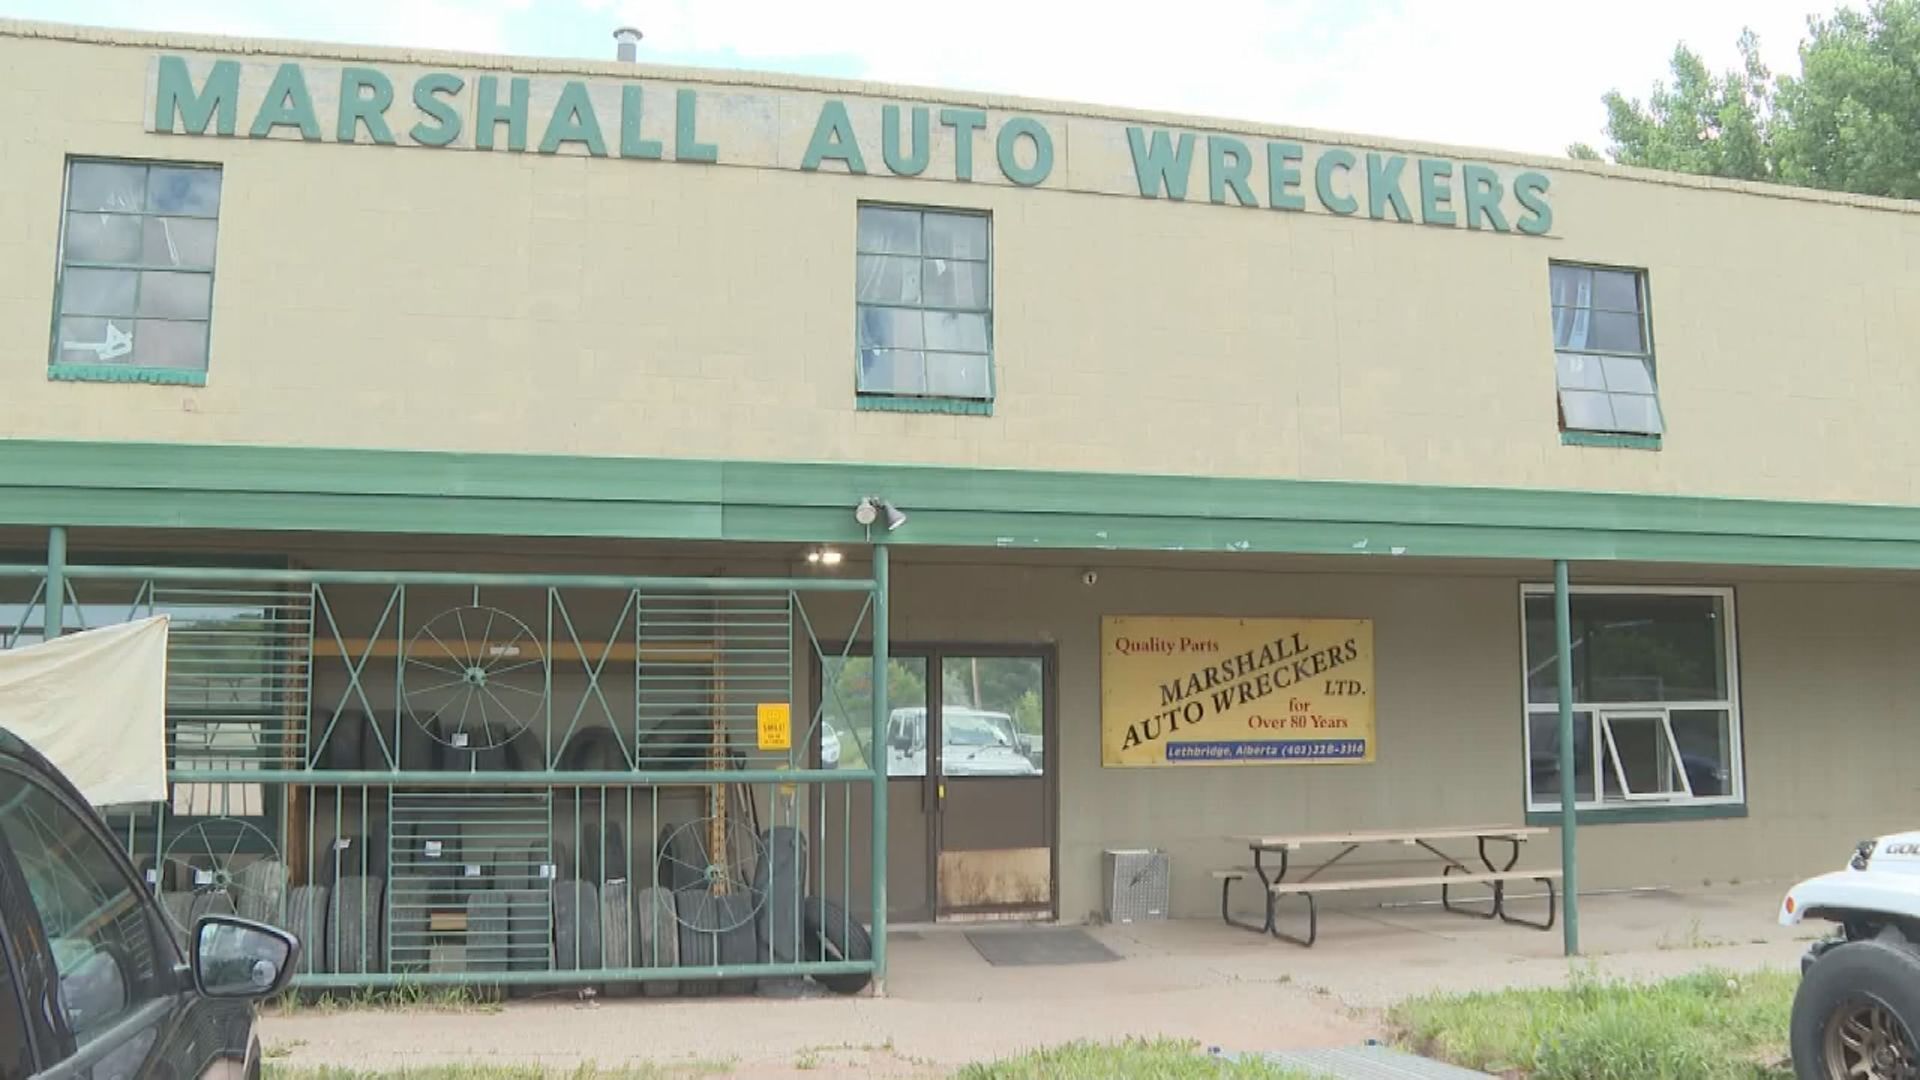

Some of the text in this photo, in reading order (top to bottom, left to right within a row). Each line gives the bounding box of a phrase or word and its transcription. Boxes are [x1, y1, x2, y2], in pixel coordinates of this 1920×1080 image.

[155, 54, 1553, 237] MARSHALL AUTO WRECKERS
[1115, 637, 1219, 656] Quality Parts
[1160, 631, 1310, 706] MARSHALL
[1121, 638, 1358, 750] AUTO WRECKERS
[1324, 680, 1366, 697] LTD.
[1288, 697, 1312, 712] for
[1248, 715, 1348, 729] Over 80 Years
[1168, 745, 1232, 759] Lethbridge,
[1235, 745, 1278, 757] Alberta
